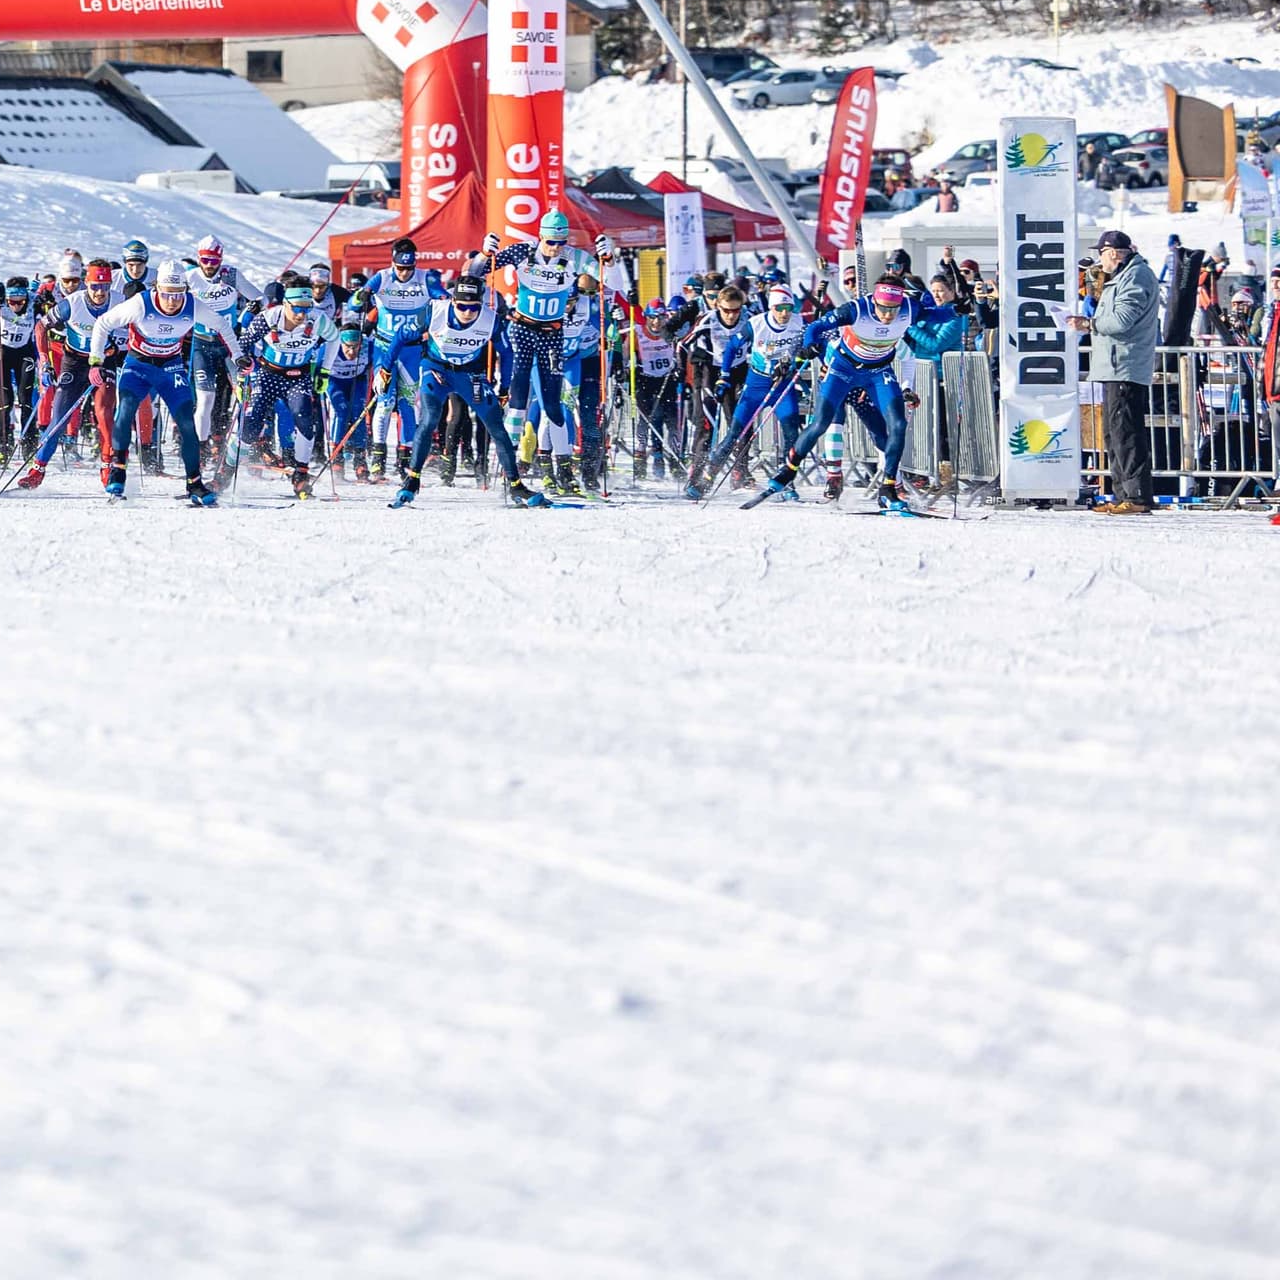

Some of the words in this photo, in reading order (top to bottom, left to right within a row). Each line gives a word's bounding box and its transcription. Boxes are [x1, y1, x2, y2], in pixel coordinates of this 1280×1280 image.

[516, 32, 555, 43] SAVOIE
[428, 123, 457, 203] sav
[827, 85, 871, 250] MADSHUS
[591, 192, 637, 201] OMON
[414, 251, 442, 260] ome
[381, 287, 425, 299] ekosport
[1010, 214, 1066, 385] DÉPART
[527, 295, 559, 316] 110
[1, 329, 23, 342] 216
[434, 332, 487, 347] eosport
[649, 358, 670, 370] 169
